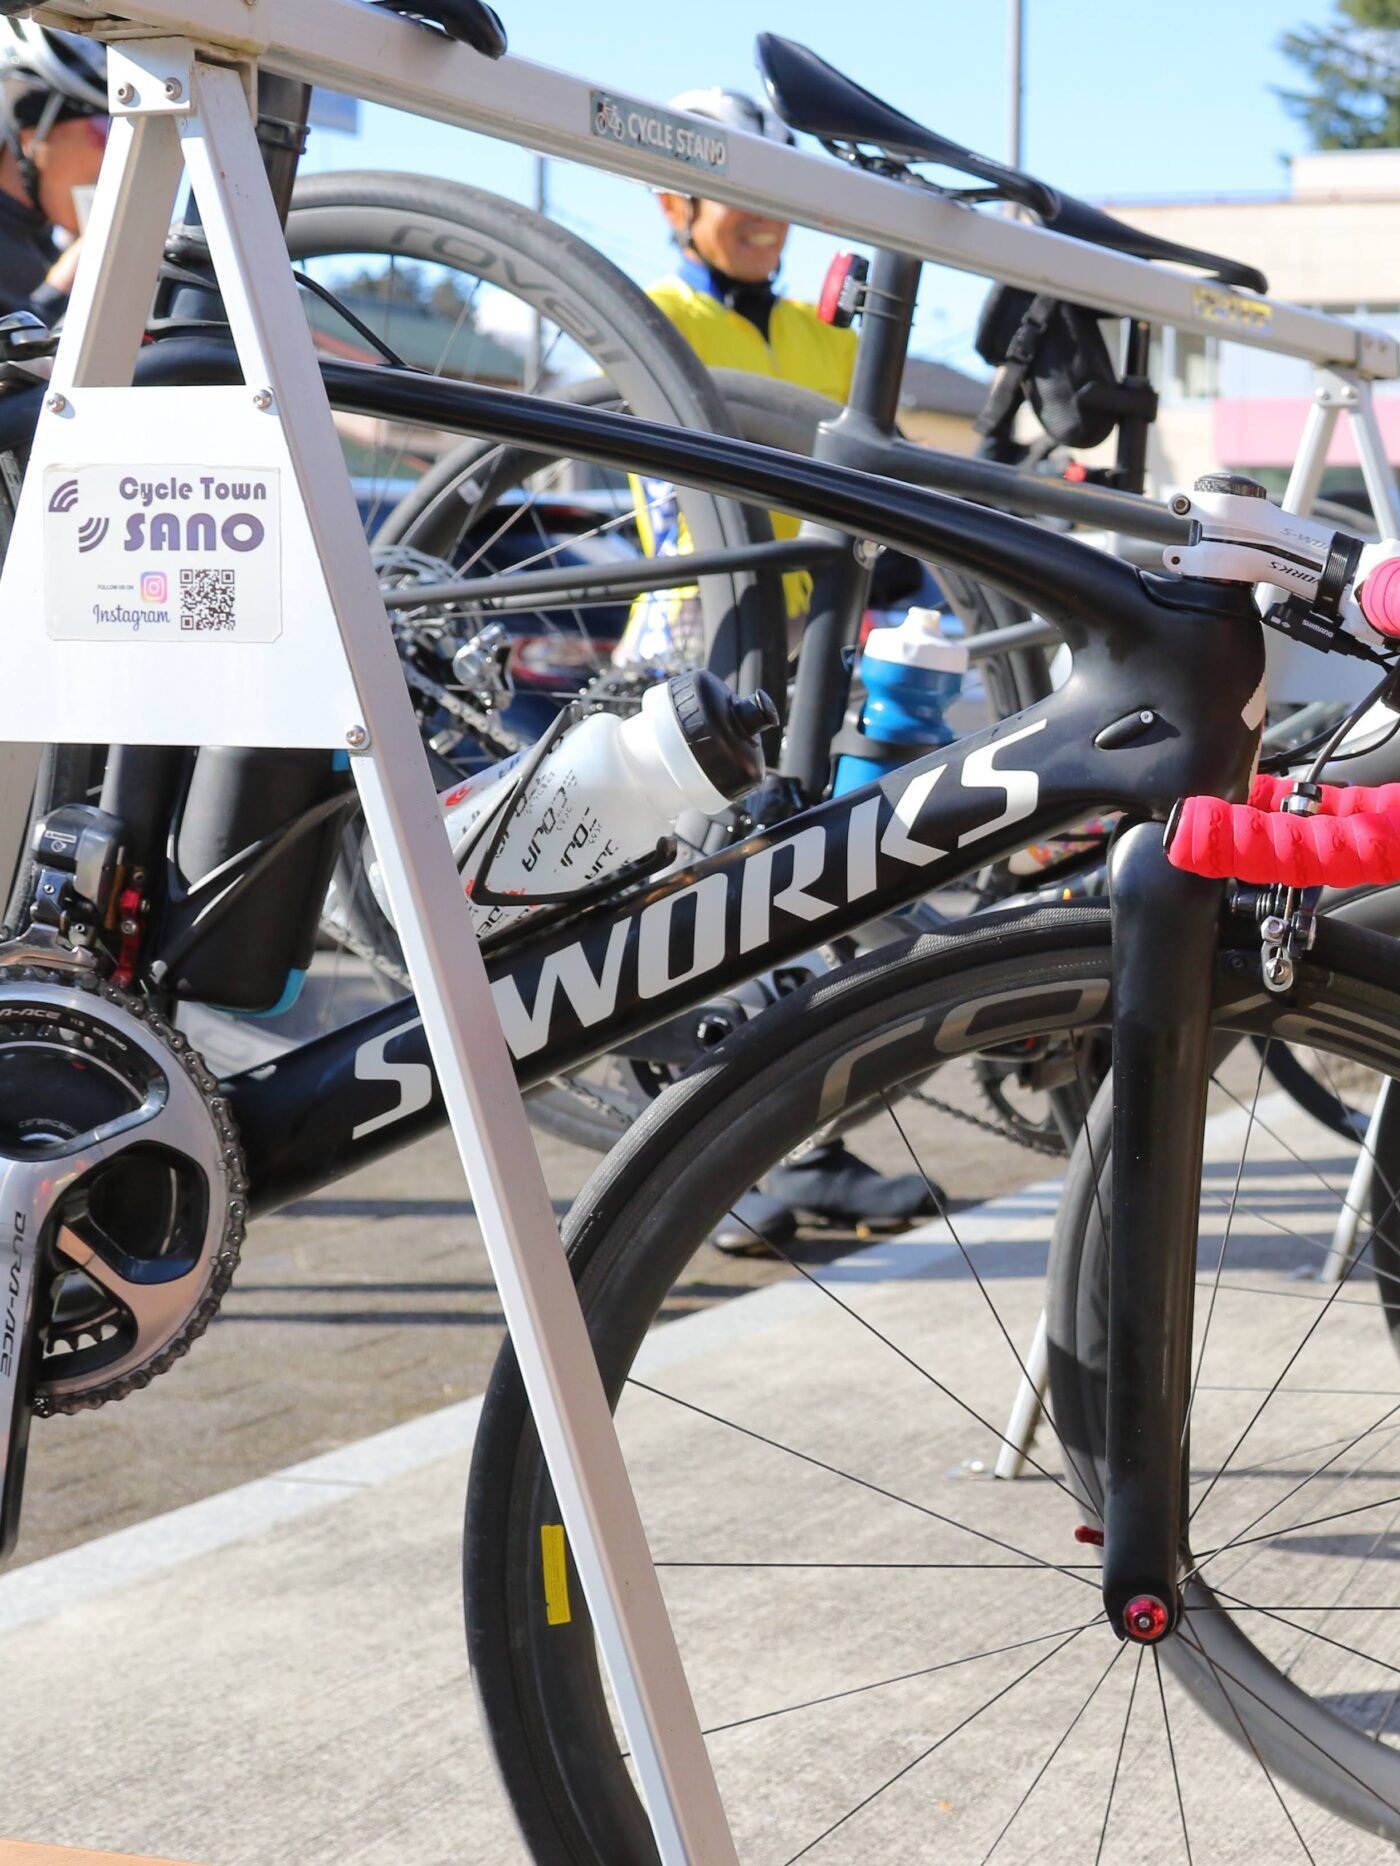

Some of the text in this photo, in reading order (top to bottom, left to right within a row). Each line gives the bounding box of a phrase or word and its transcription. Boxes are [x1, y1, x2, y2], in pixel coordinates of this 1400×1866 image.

[627, 112, 726, 165] CYCLE STAND
[390, 225, 631, 364] roval
[118, 476, 266, 507] Cycle Town
[124, 512, 265, 552] SANO
[1267, 560, 1321, 585] ORKS
[92, 604, 170, 632] Instagram
[1302, 619, 1335, 639] SHIMANO
[1, 1210, 26, 1377] DURA-ACE
